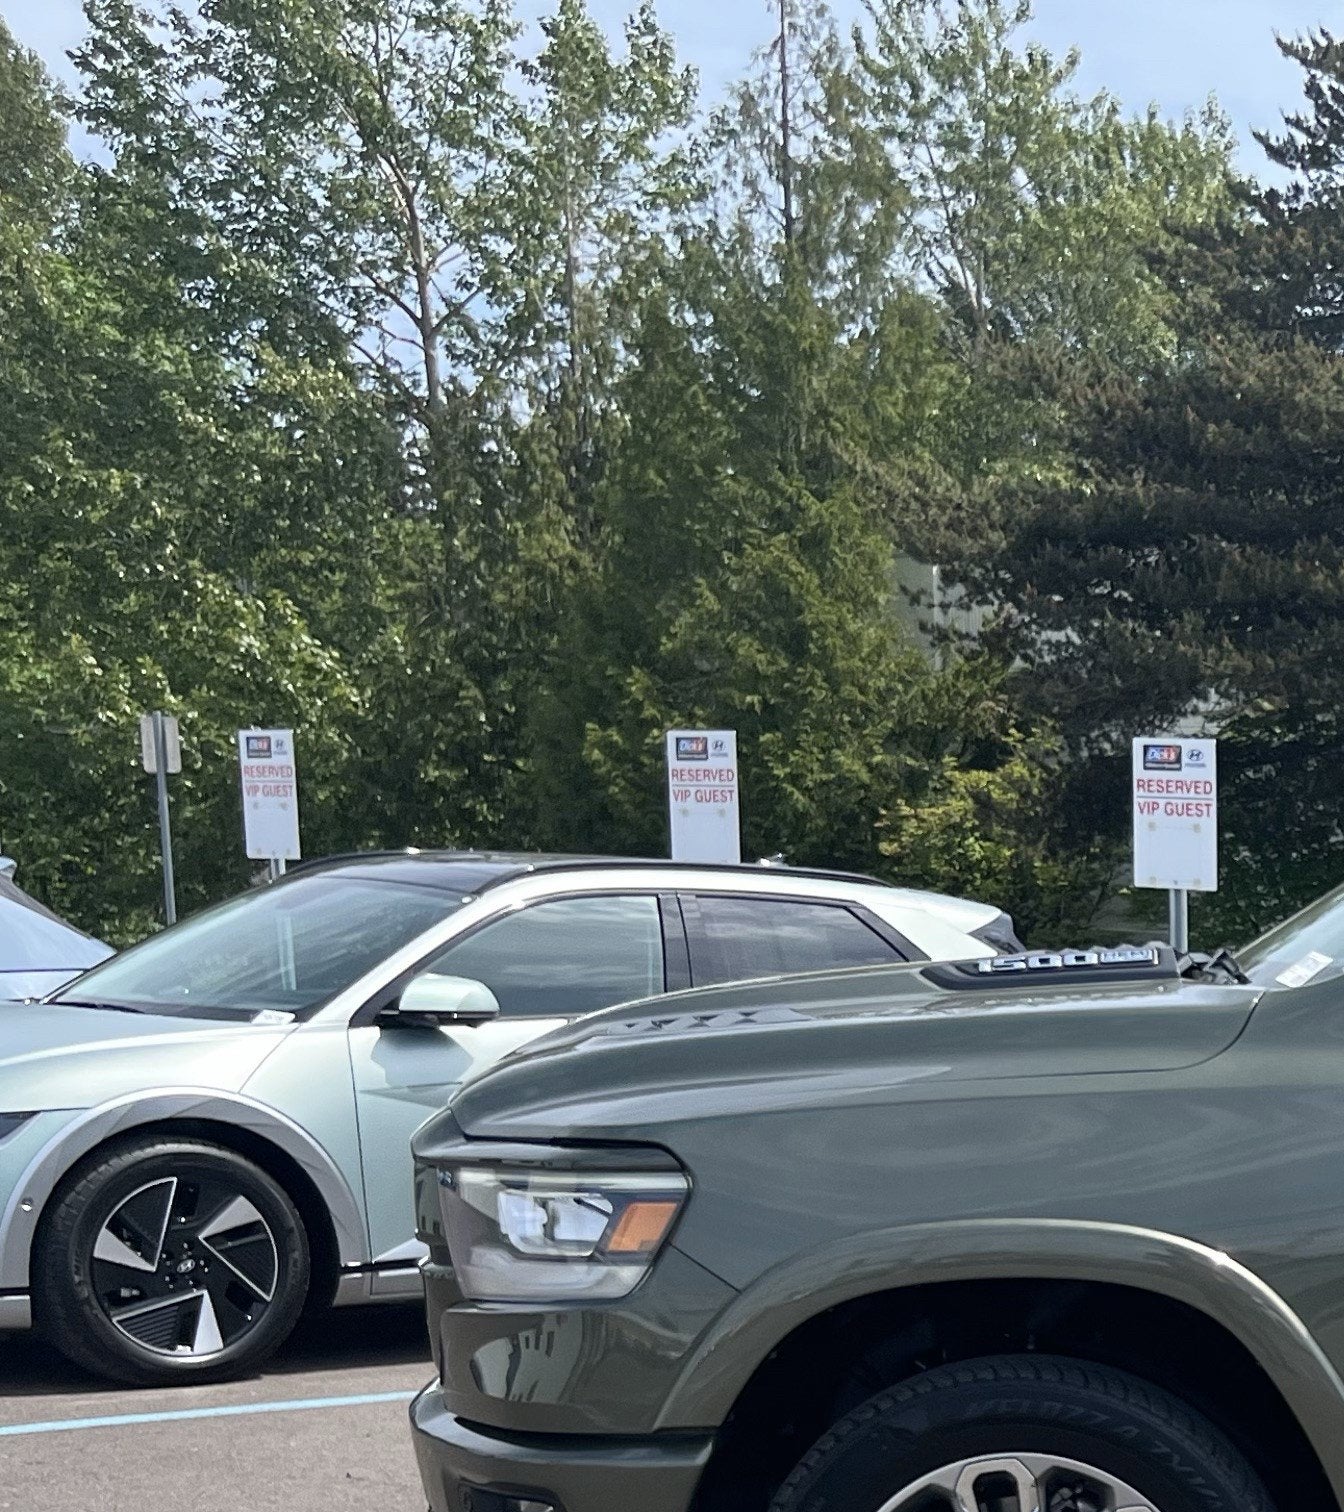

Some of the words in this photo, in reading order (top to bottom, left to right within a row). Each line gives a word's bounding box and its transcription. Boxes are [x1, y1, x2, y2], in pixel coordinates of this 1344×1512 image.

[243, 765, 292, 778] RESERVED
[671, 769, 734, 782] RESERVED
[1136, 779, 1213, 795] RESERVED
[672, 789, 691, 802] VIP
[694, 789, 734, 803] GUEST
[1137, 801, 1160, 814] VIP
[1164, 802, 1213, 818] GUEST
[978, 953, 1099, 973] 1500
